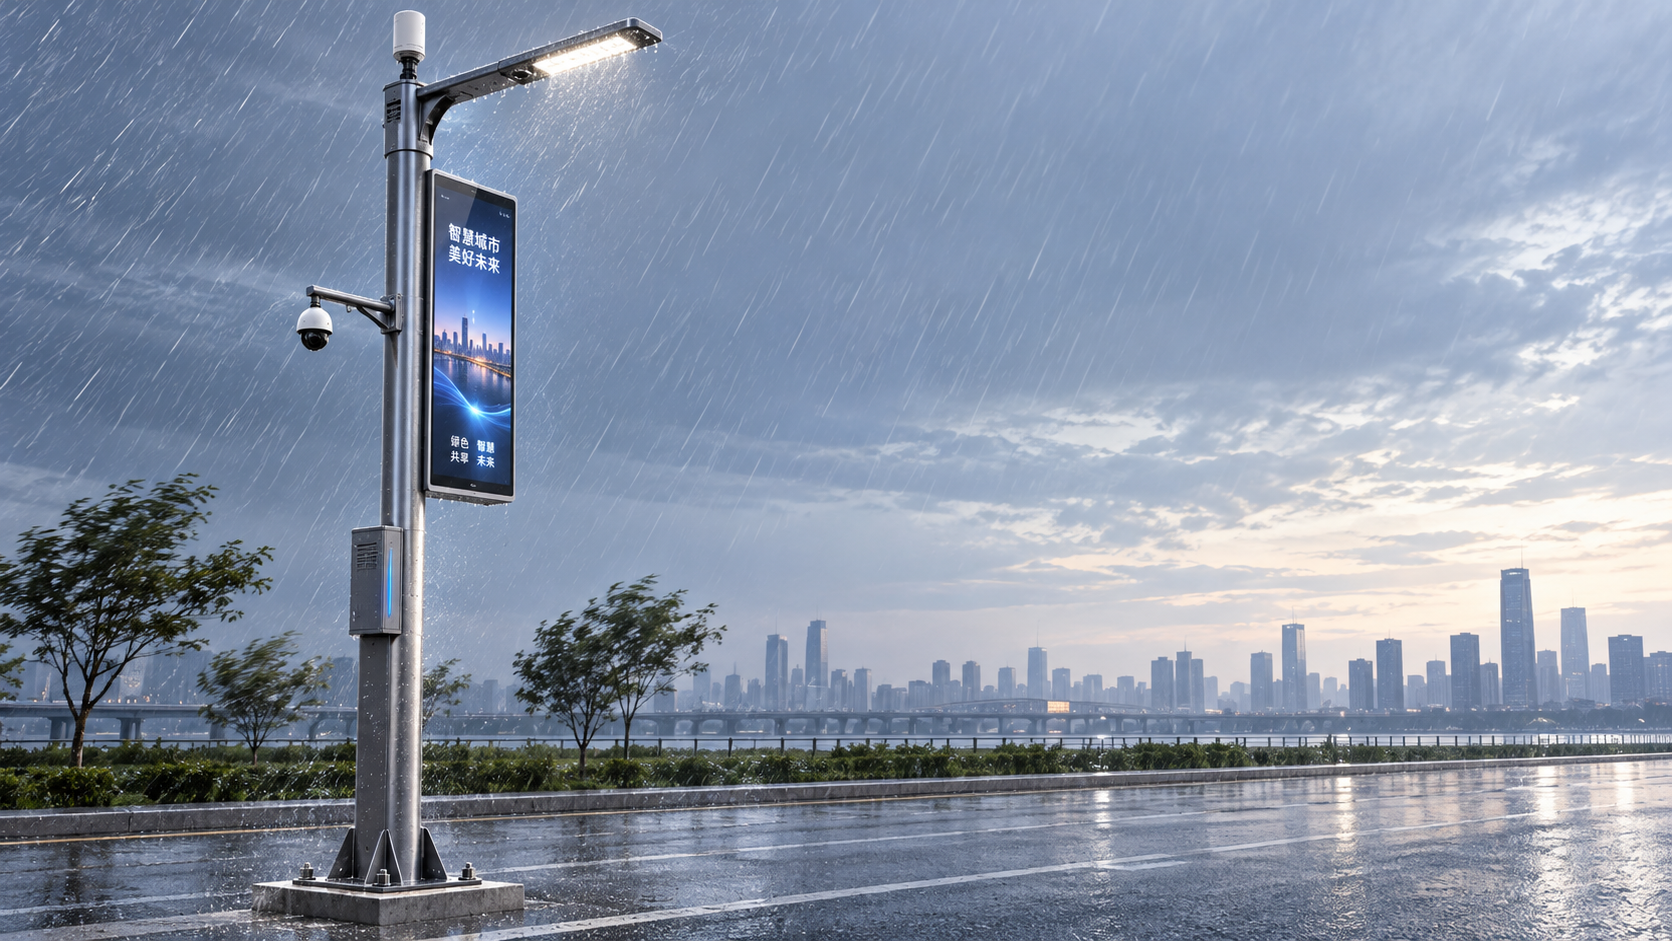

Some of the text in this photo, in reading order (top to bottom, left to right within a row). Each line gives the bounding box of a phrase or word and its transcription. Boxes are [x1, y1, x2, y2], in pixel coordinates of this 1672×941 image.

[448, 222, 500, 253] 智慧城市
[448, 244, 500, 274] 美好未来
[476, 455, 495, 468] 未来
